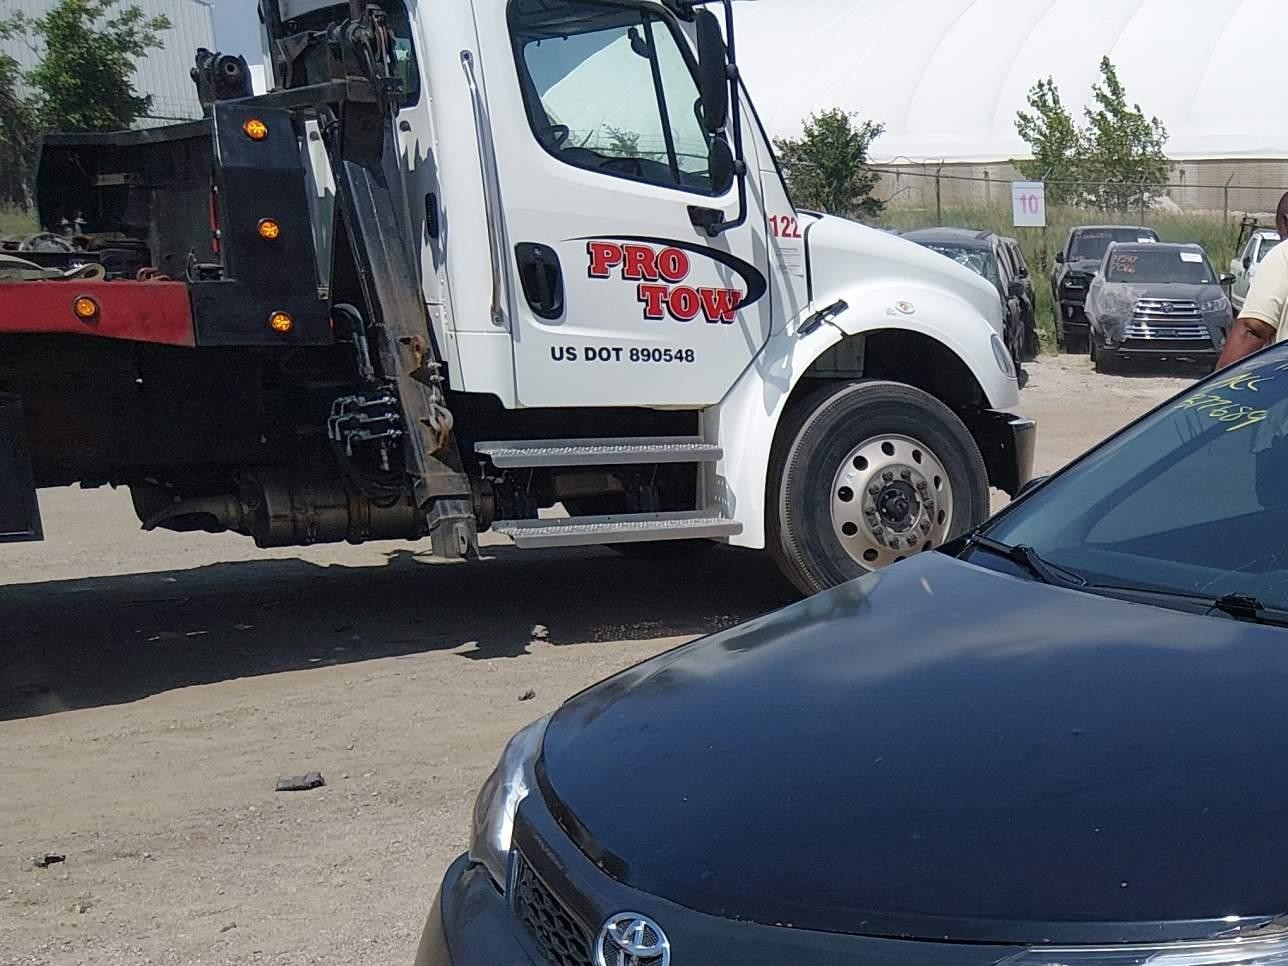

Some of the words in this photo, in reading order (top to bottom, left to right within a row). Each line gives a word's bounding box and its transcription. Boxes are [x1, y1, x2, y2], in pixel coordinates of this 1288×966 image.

[1019, 193, 1039, 215] 10
[768, 214, 802, 238] 122
[586, 240, 691, 283] PRO
[637, 283, 744, 325] TOW
[550, 345, 578, 361] US
[584, 346, 623, 362] DOT
[629, 347, 695, 363] 890548
